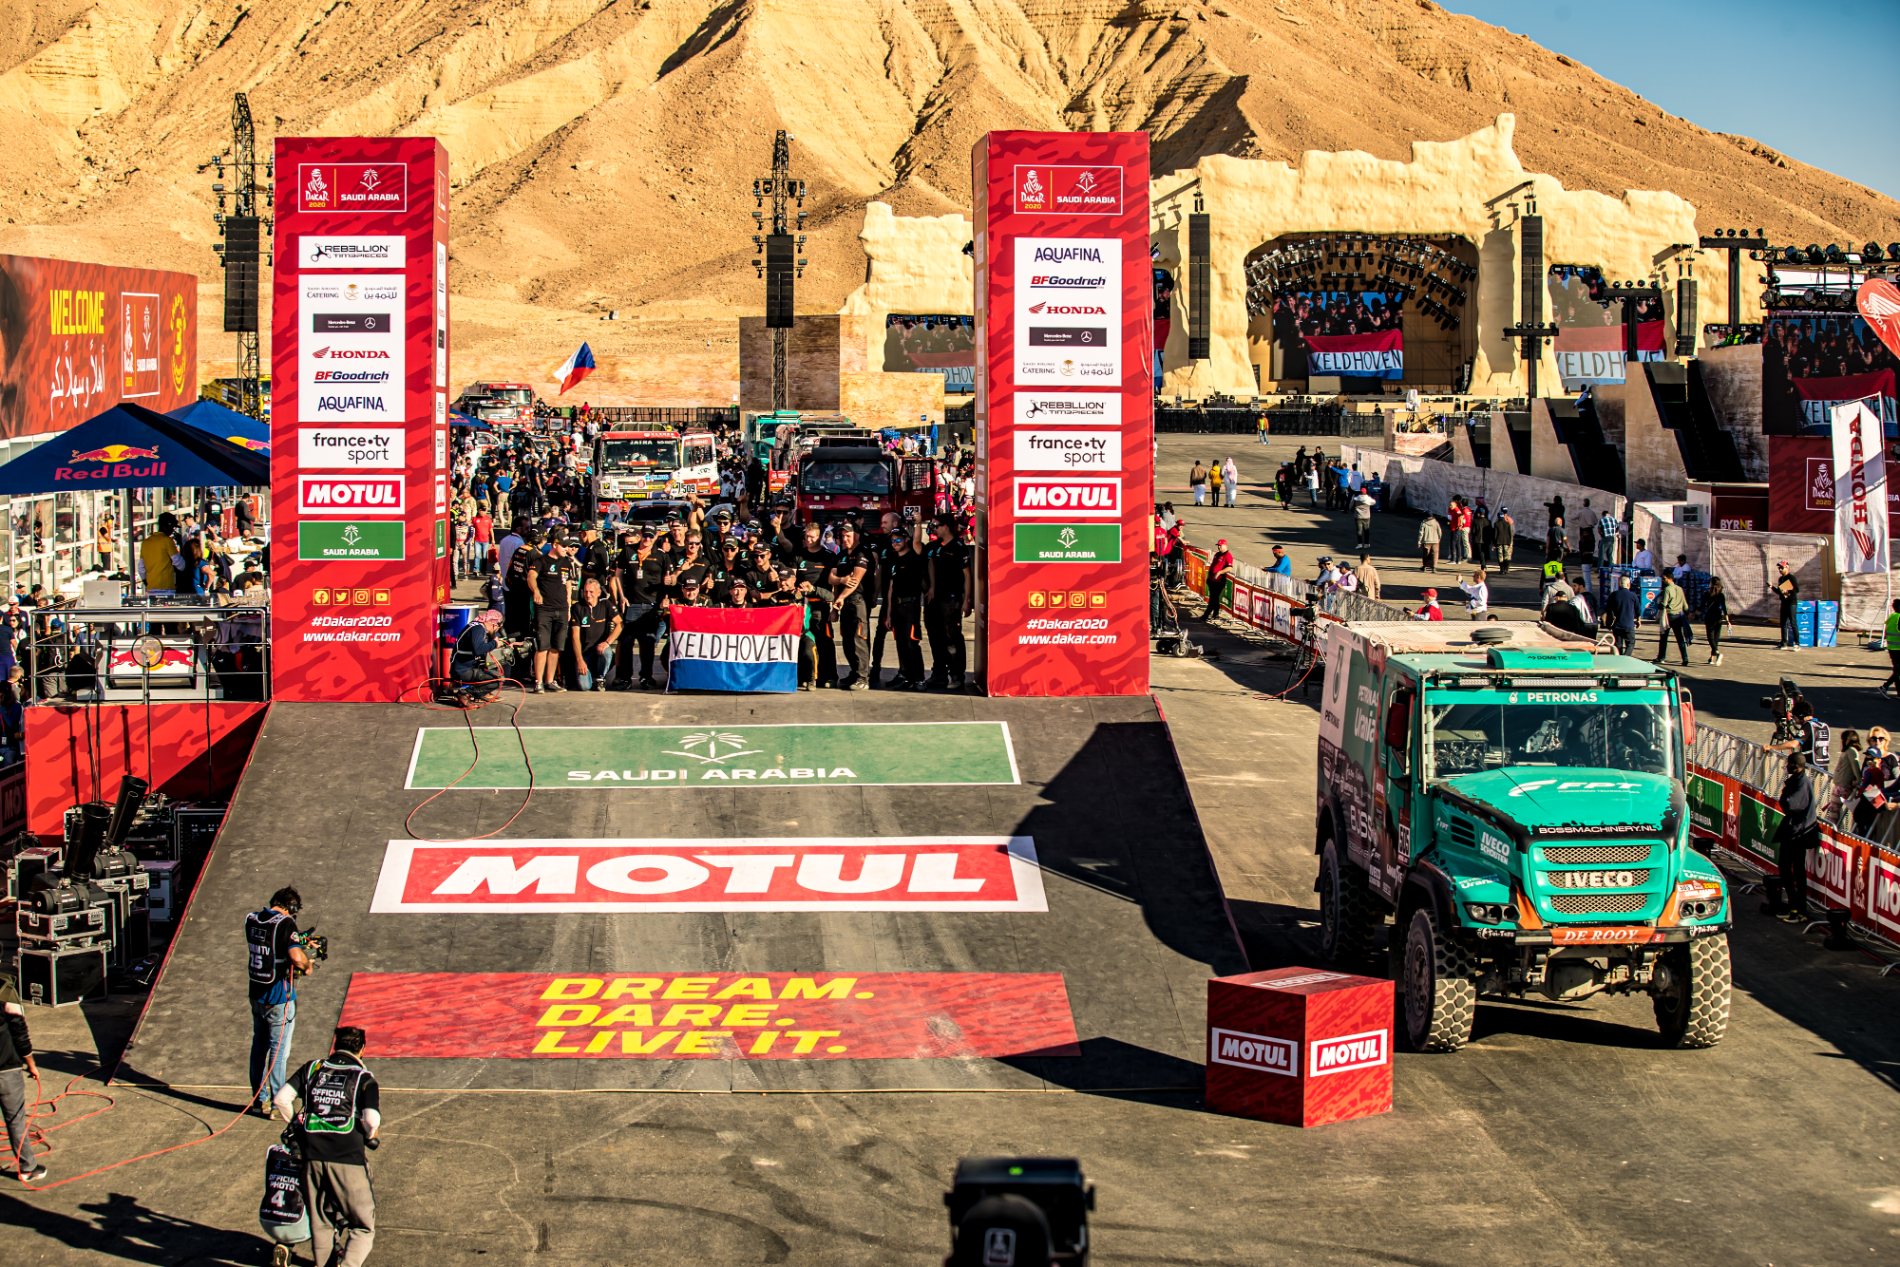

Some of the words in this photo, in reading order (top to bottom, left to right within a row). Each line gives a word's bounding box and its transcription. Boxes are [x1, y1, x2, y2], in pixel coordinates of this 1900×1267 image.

[305, 190, 329, 202] DAKAR
[341, 193, 366, 201] SAUDI
[368, 193, 400, 201] ARABIA
[1021, 191, 1045, 203] DAKAR
[1057, 195, 1082, 203] SAUDI
[1084, 196, 1115, 204] ARABIA
[1034, 247, 1101, 263] AQUAFINA
[1030, 275, 1106, 286] BFGoodrich
[50, 289, 105, 335] WELCOME
[1047, 306, 1107, 315] HONDA
[331, 350, 390, 359] HONDA
[1308, 349, 1402, 371] VELDHOVEN
[314, 371, 390, 380] BFGoodrich
[318, 396, 385, 412] AQUAFINA
[347, 448, 389, 464] sport
[1064, 451, 1105, 467] sport
[54, 464, 109, 480] Red
[113, 462, 167, 478] Bull
[1849, 412, 1869, 525] HONDA
[307, 484, 397, 504] MOTUL
[1022, 486, 1113, 506] MOTUL
[1812, 486, 1835, 499] DAKAR
[1720, 518, 1753, 530] BYRNE
[323, 548, 347, 556] SAUDI
[349, 548, 380, 556] ARABIA
[1039, 551, 1063, 559] SAUDI
[1065, 551, 1096, 559] ARABIA
[311, 616, 392, 627] #Dakar2020
[1027, 618, 1108, 630] #Dakar2020
[303, 631, 401, 642] www.dakar.com
[1018, 633, 1117, 645] www.dakar.com
[671, 632, 793, 662] VELDHOVEN
[1527, 692, 1598, 703] PETRONAS
[567, 769, 687, 781] SAUDI
[700, 767, 857, 780] ARABIA
[1556, 782, 1643, 790] FPT
[1539, 825, 1657, 834] BOSSMACHINERY.NL
[1482, 831, 1510, 857] IVECO
[432, 853, 986, 895] MOTUL
[1805, 846, 1845, 891] MOTUL
[1564, 871, 1635, 887] IVECO
[1877, 875, 1900, 917] MO
[1563, 930, 1588, 941] DE
[1591, 929, 1639, 940] ROOY
[539, 977, 875, 1000] DREAM.
[536, 1003, 796, 1027] DARE.
[531, 1030, 733, 1055] LIVE
[749, 1030, 848, 1055] IT.
[1221, 1037, 1288, 1066] MOTUL
[1319, 1038, 1379, 1068] MOTUL
[311, 1087, 346, 1099] OFFICIAL
[313, 1095, 341, 1106] PHOTO
[268, 1174, 300, 1186] OFFICIAL
[270, 1181, 295, 1192] PHOTO
[271, 1189, 286, 1208] 4
